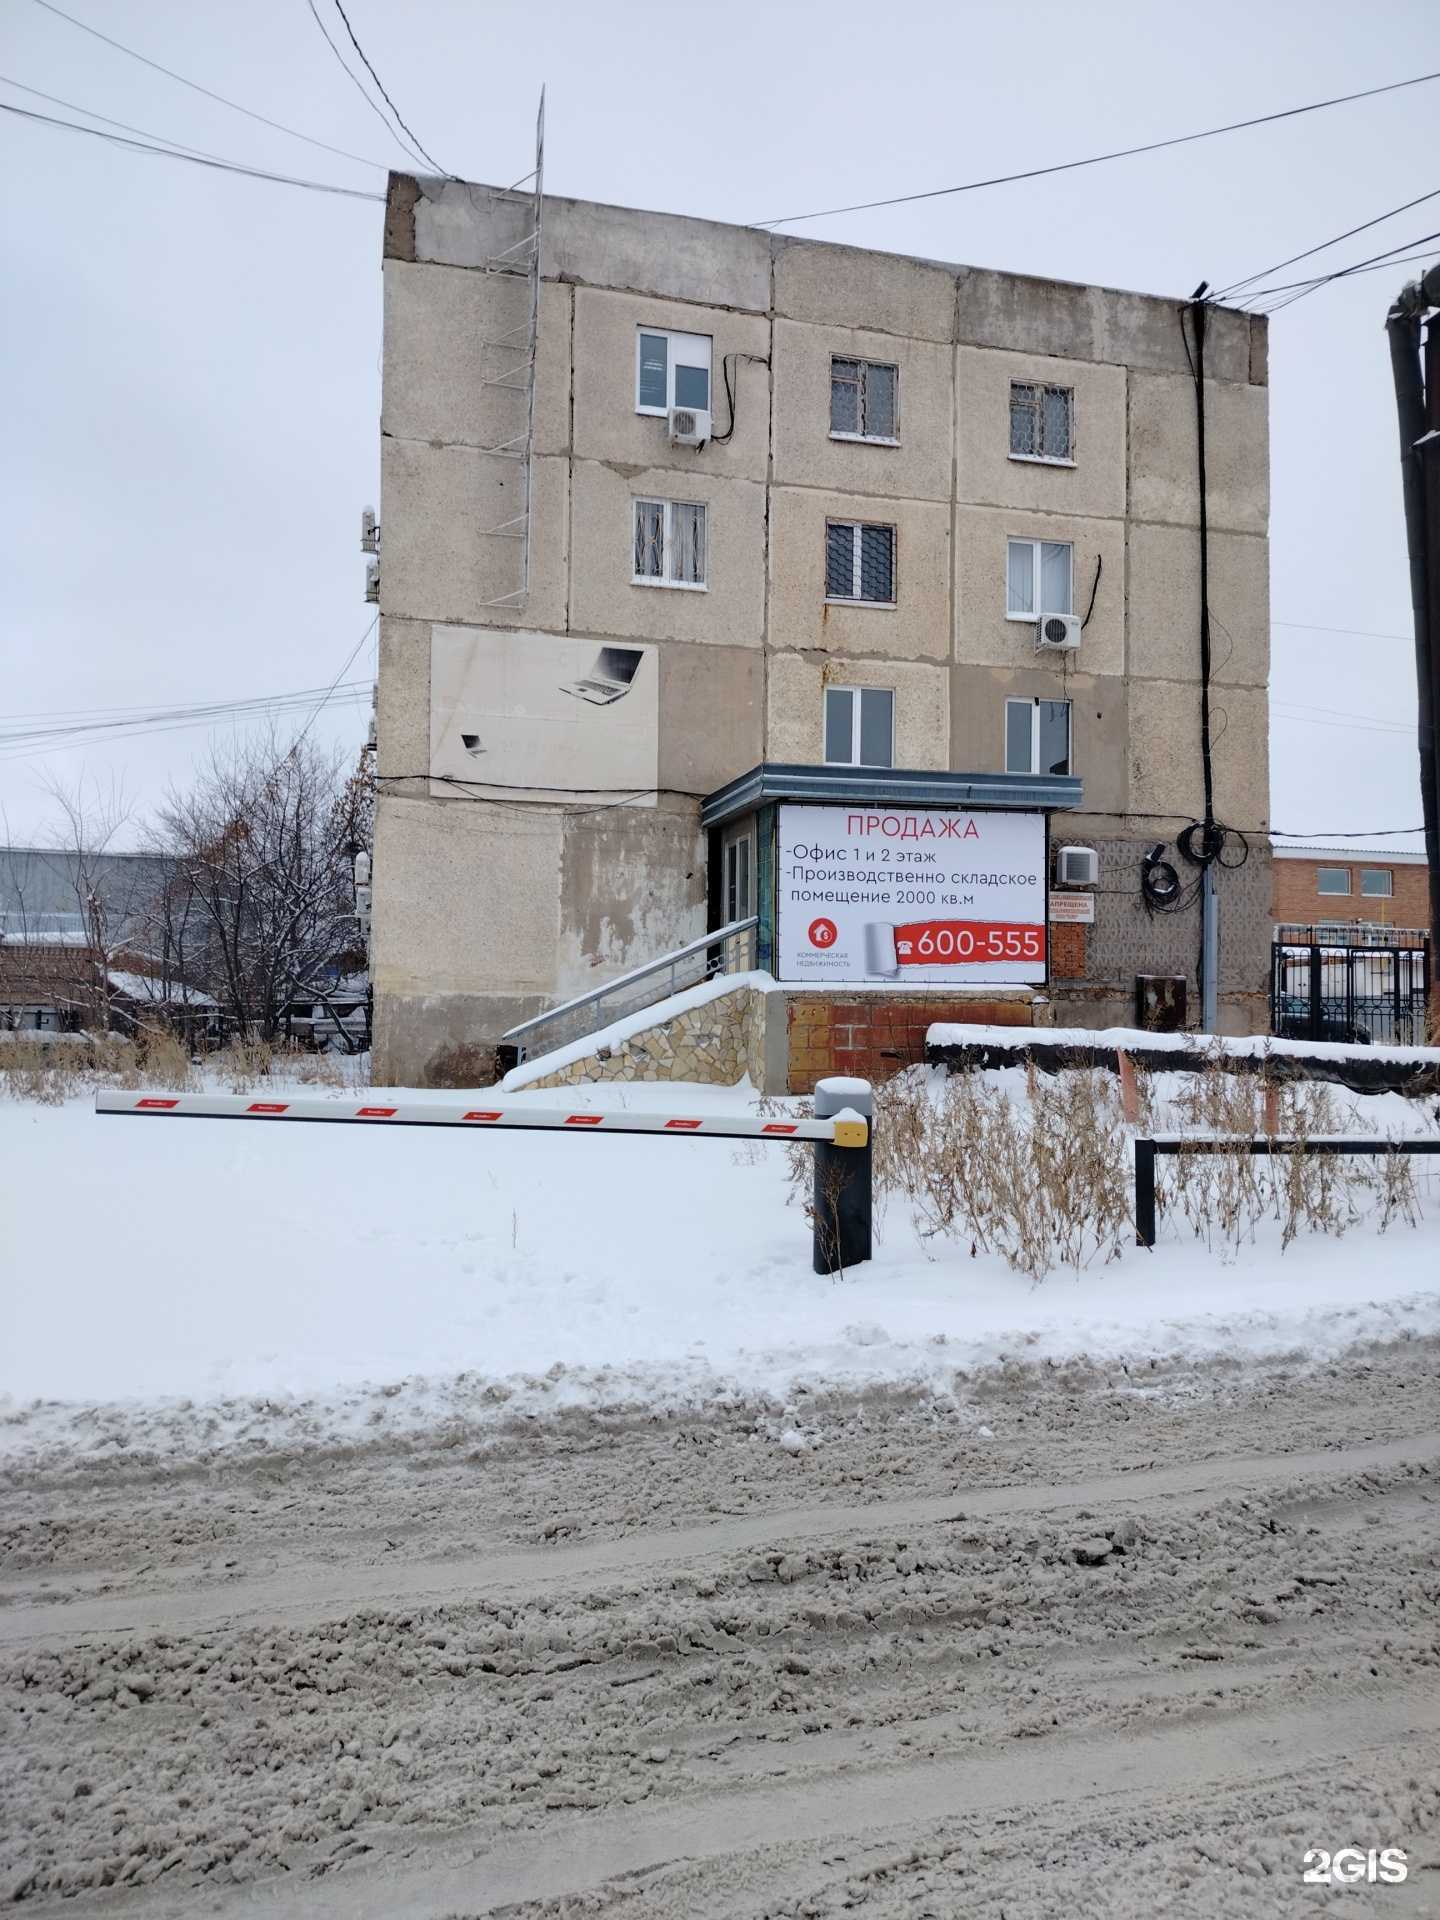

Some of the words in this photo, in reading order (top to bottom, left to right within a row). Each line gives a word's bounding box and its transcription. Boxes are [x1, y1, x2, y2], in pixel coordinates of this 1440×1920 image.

[847, 815, 980, 841] ПРОДАЖА
[785, 843, 848, 863] -Офис
[853, 848, 860, 861] 1
[866, 851, 875, 861] и
[881, 848, 891, 862] 2
[896, 851, 937, 863] этаж
[785, 865, 946, 884] -Производственно
[951, 872, 1037, 887] складское
[791, 890, 891, 904] помещение
[896, 890, 936, 904] 2000
[941, 894, 974, 905] кв.м
[918, 930, 1039, 956] 600-555
